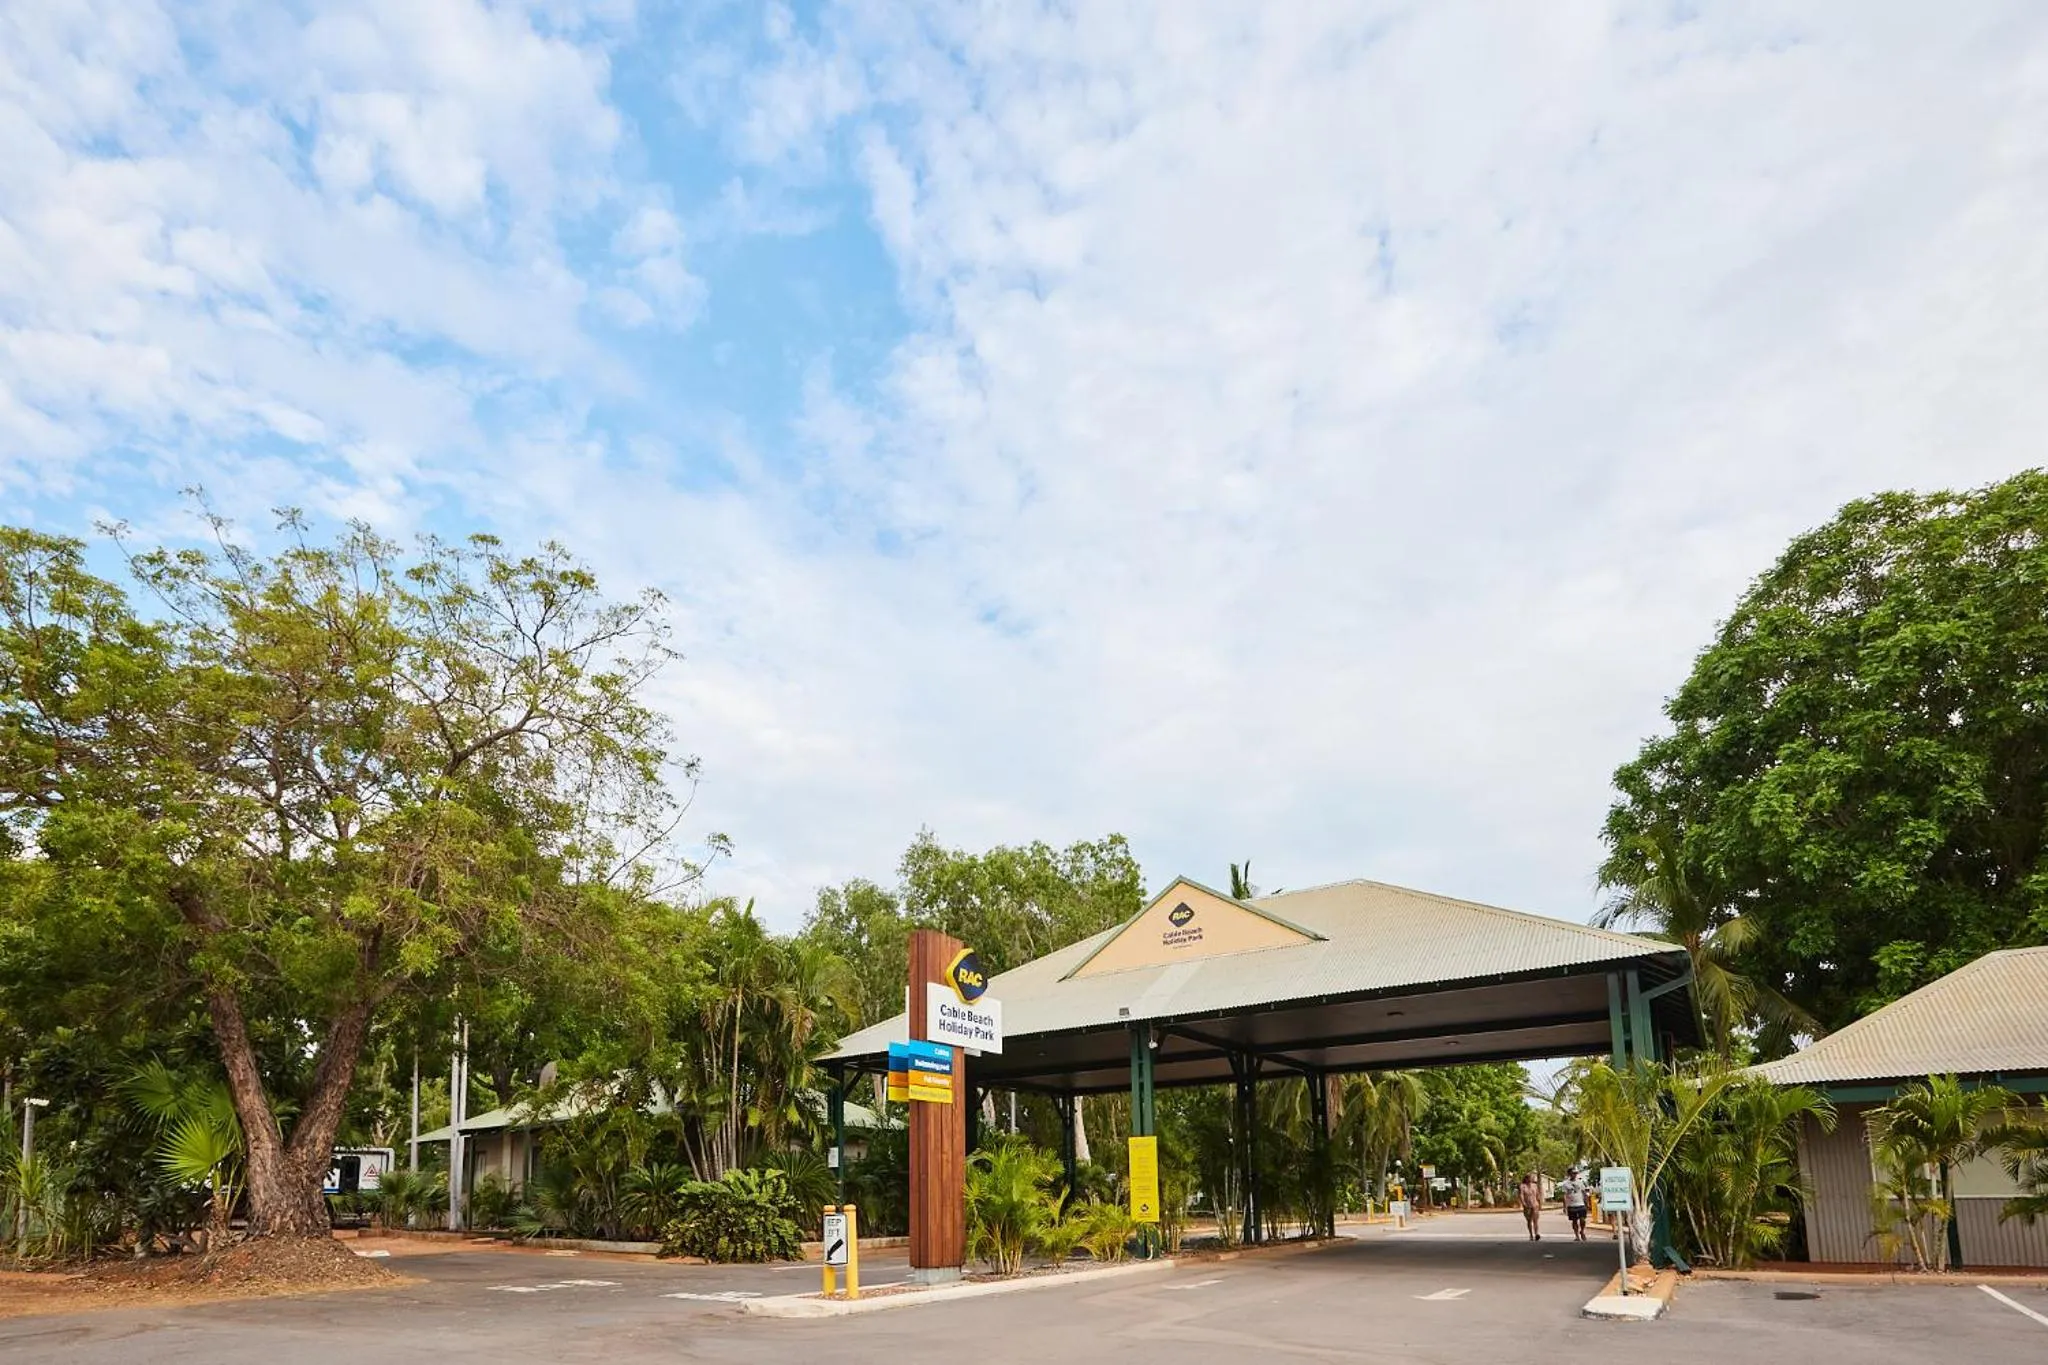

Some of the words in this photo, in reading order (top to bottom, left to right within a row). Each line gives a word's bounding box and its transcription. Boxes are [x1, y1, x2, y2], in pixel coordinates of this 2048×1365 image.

[1172, 910, 1191, 921] RAC
[1188, 934, 1203, 942] Park
[959, 968, 983, 988] RAC
[941, 1004, 966, 1021] Cable
[967, 1010, 994, 1027] Beach
[939, 1019, 974, 1040] Holiday
[974, 1026, 995, 1041] Park
